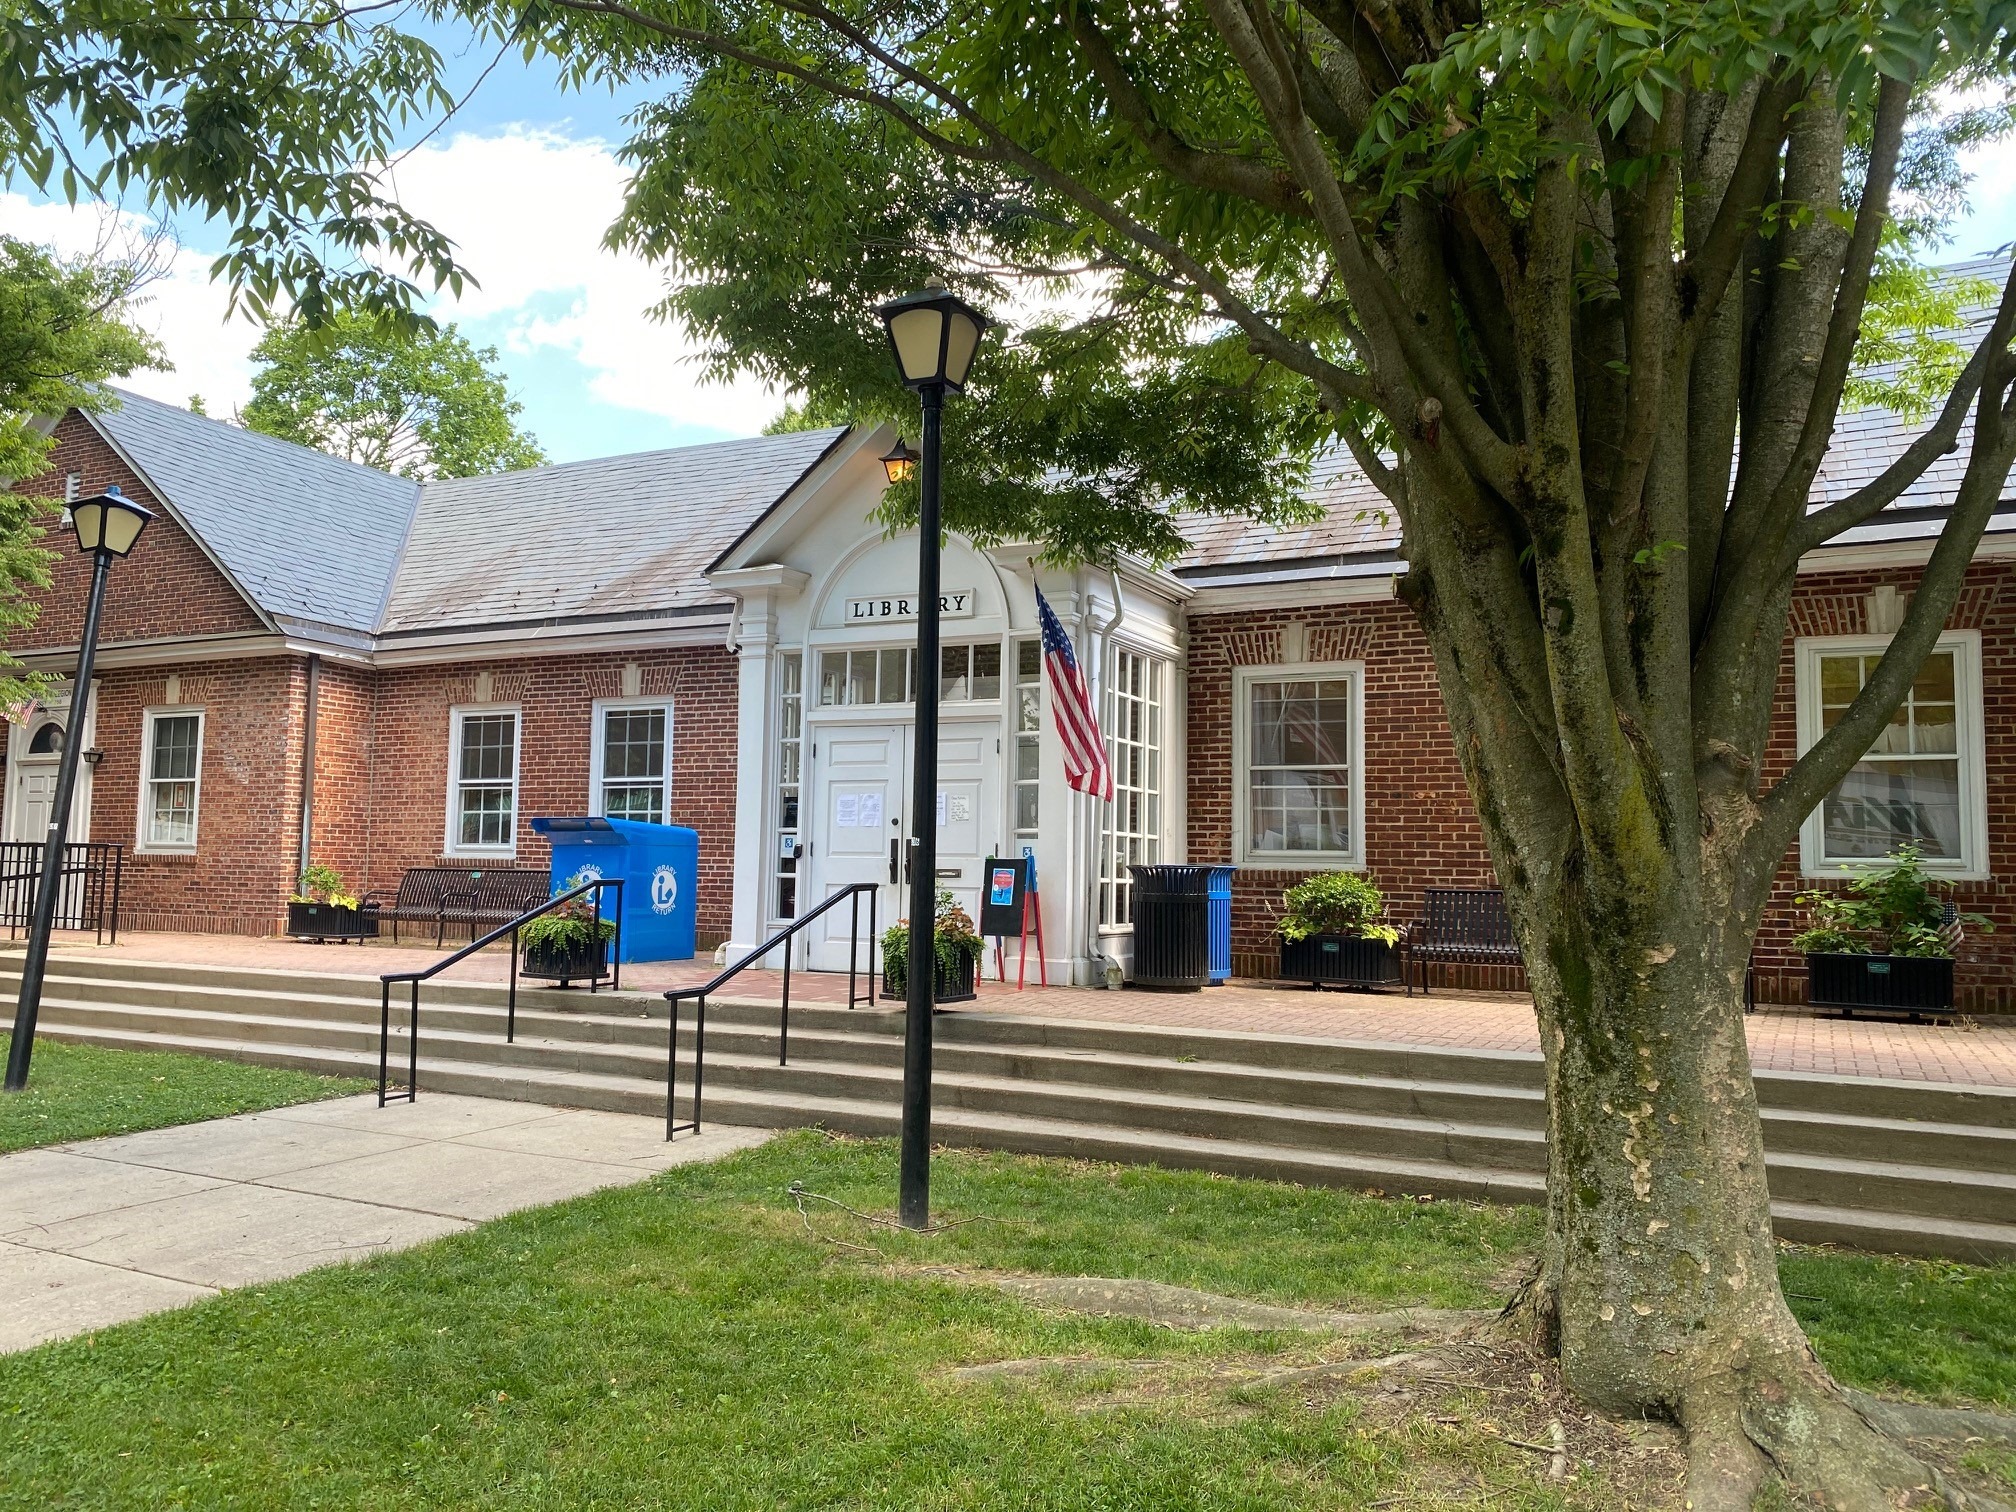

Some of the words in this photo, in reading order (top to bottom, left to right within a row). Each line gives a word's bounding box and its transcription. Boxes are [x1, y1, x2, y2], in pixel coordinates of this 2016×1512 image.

[853, 595, 966, 617] LIBRRY
[652, 864, 678, 877] LIBRARY
[651, 902, 676, 916] RETURN
